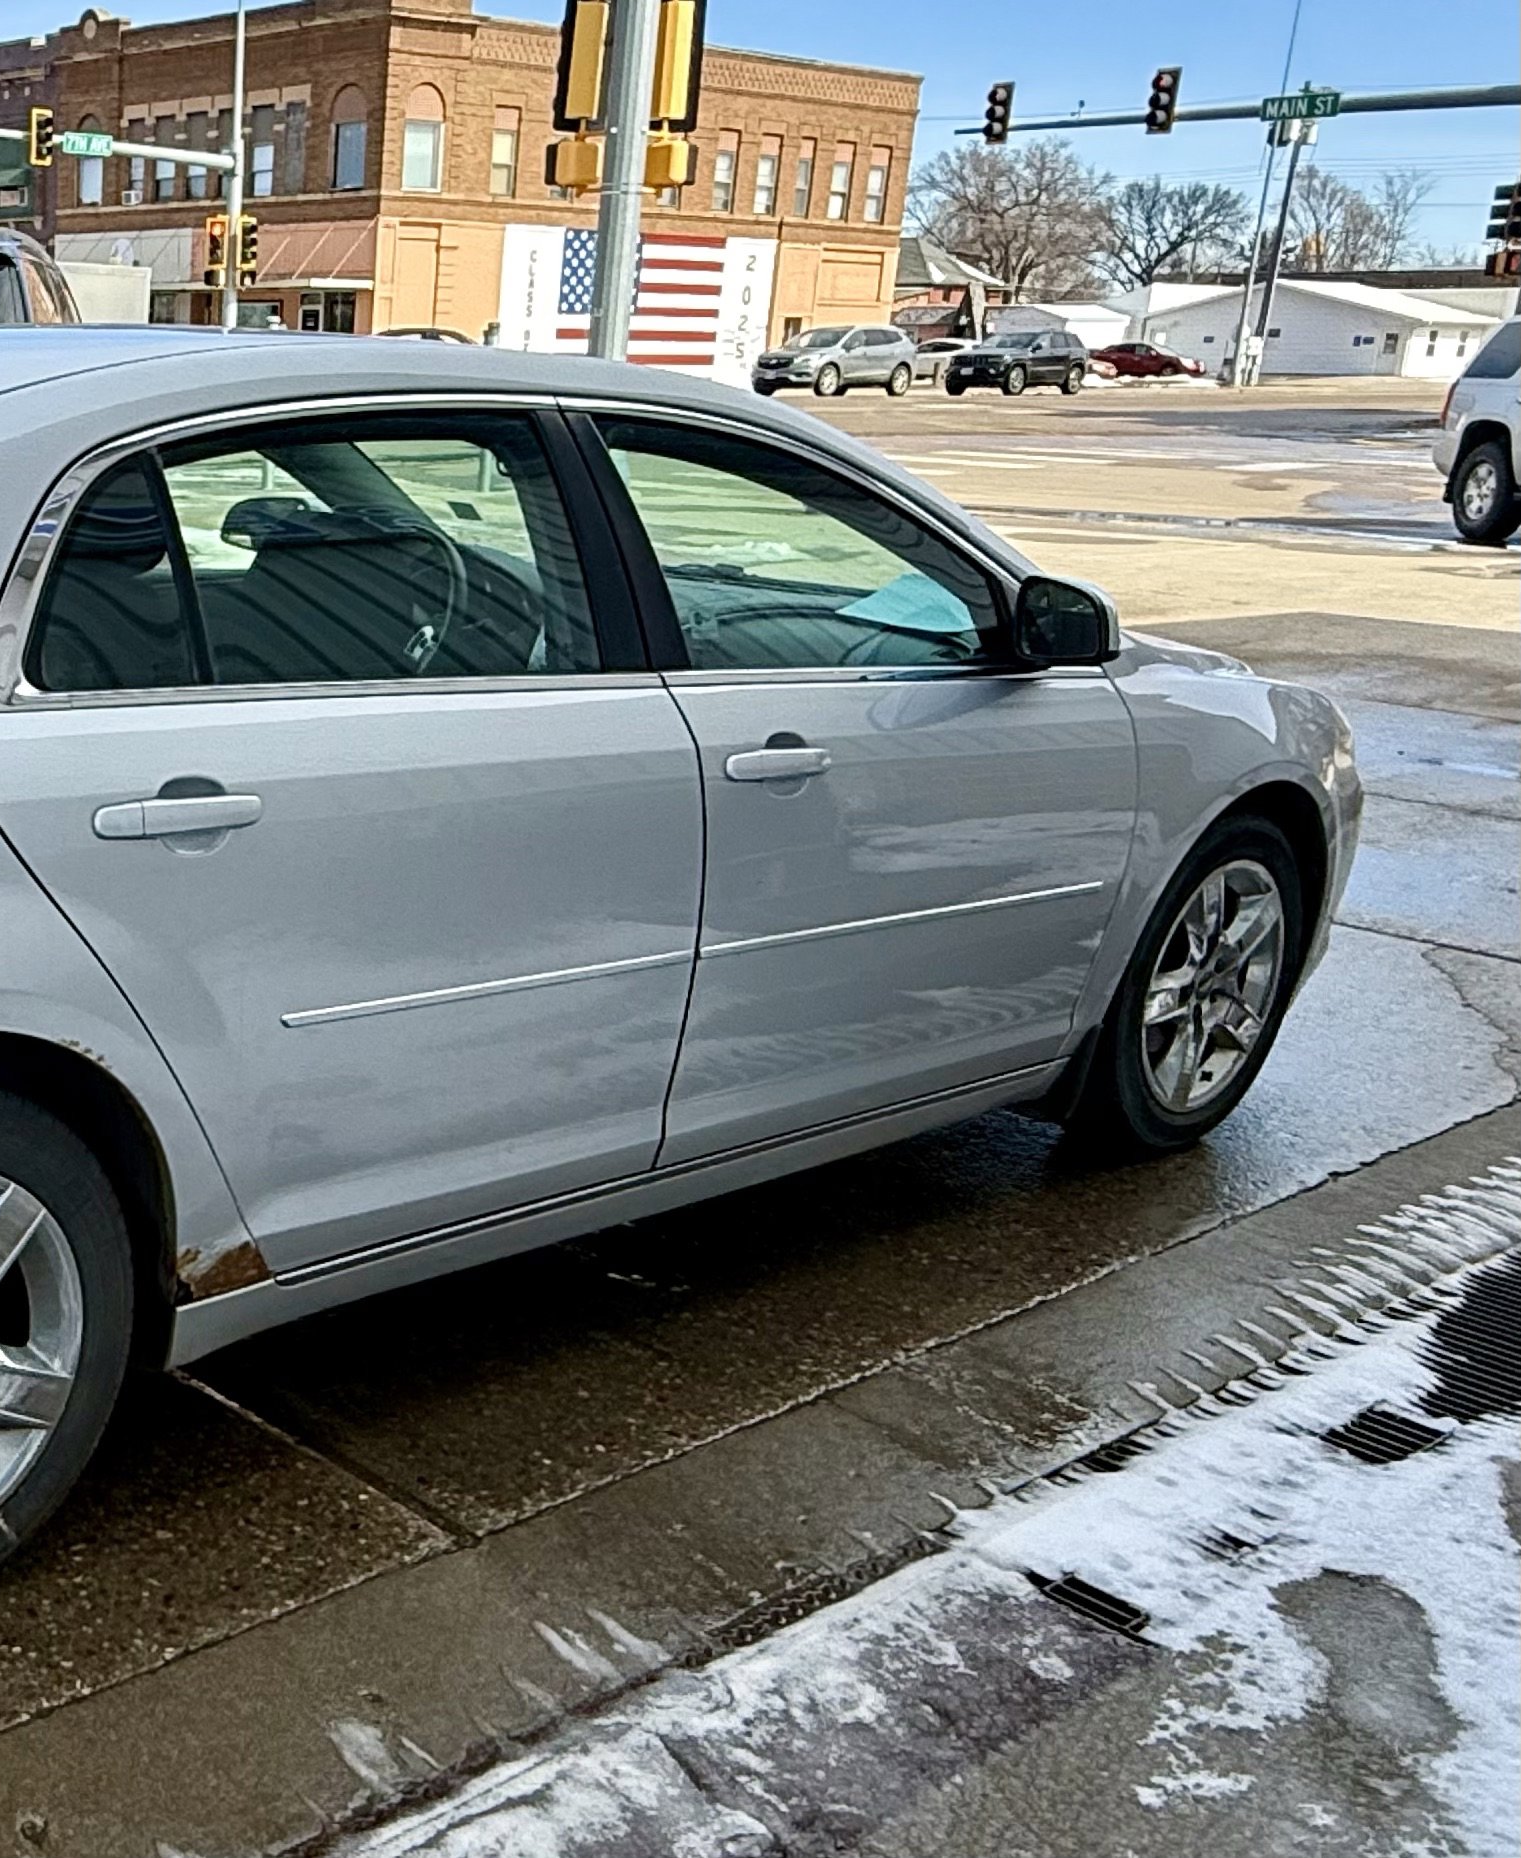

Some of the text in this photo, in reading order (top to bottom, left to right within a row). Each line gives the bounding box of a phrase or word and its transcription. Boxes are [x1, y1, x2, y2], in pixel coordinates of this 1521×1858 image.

[1266, 96, 1335, 118] MAIN ST
[66, 135, 87, 151] 7TH
[526, 250, 537, 318] CLASS
[735, 255, 756, 359] 2025
